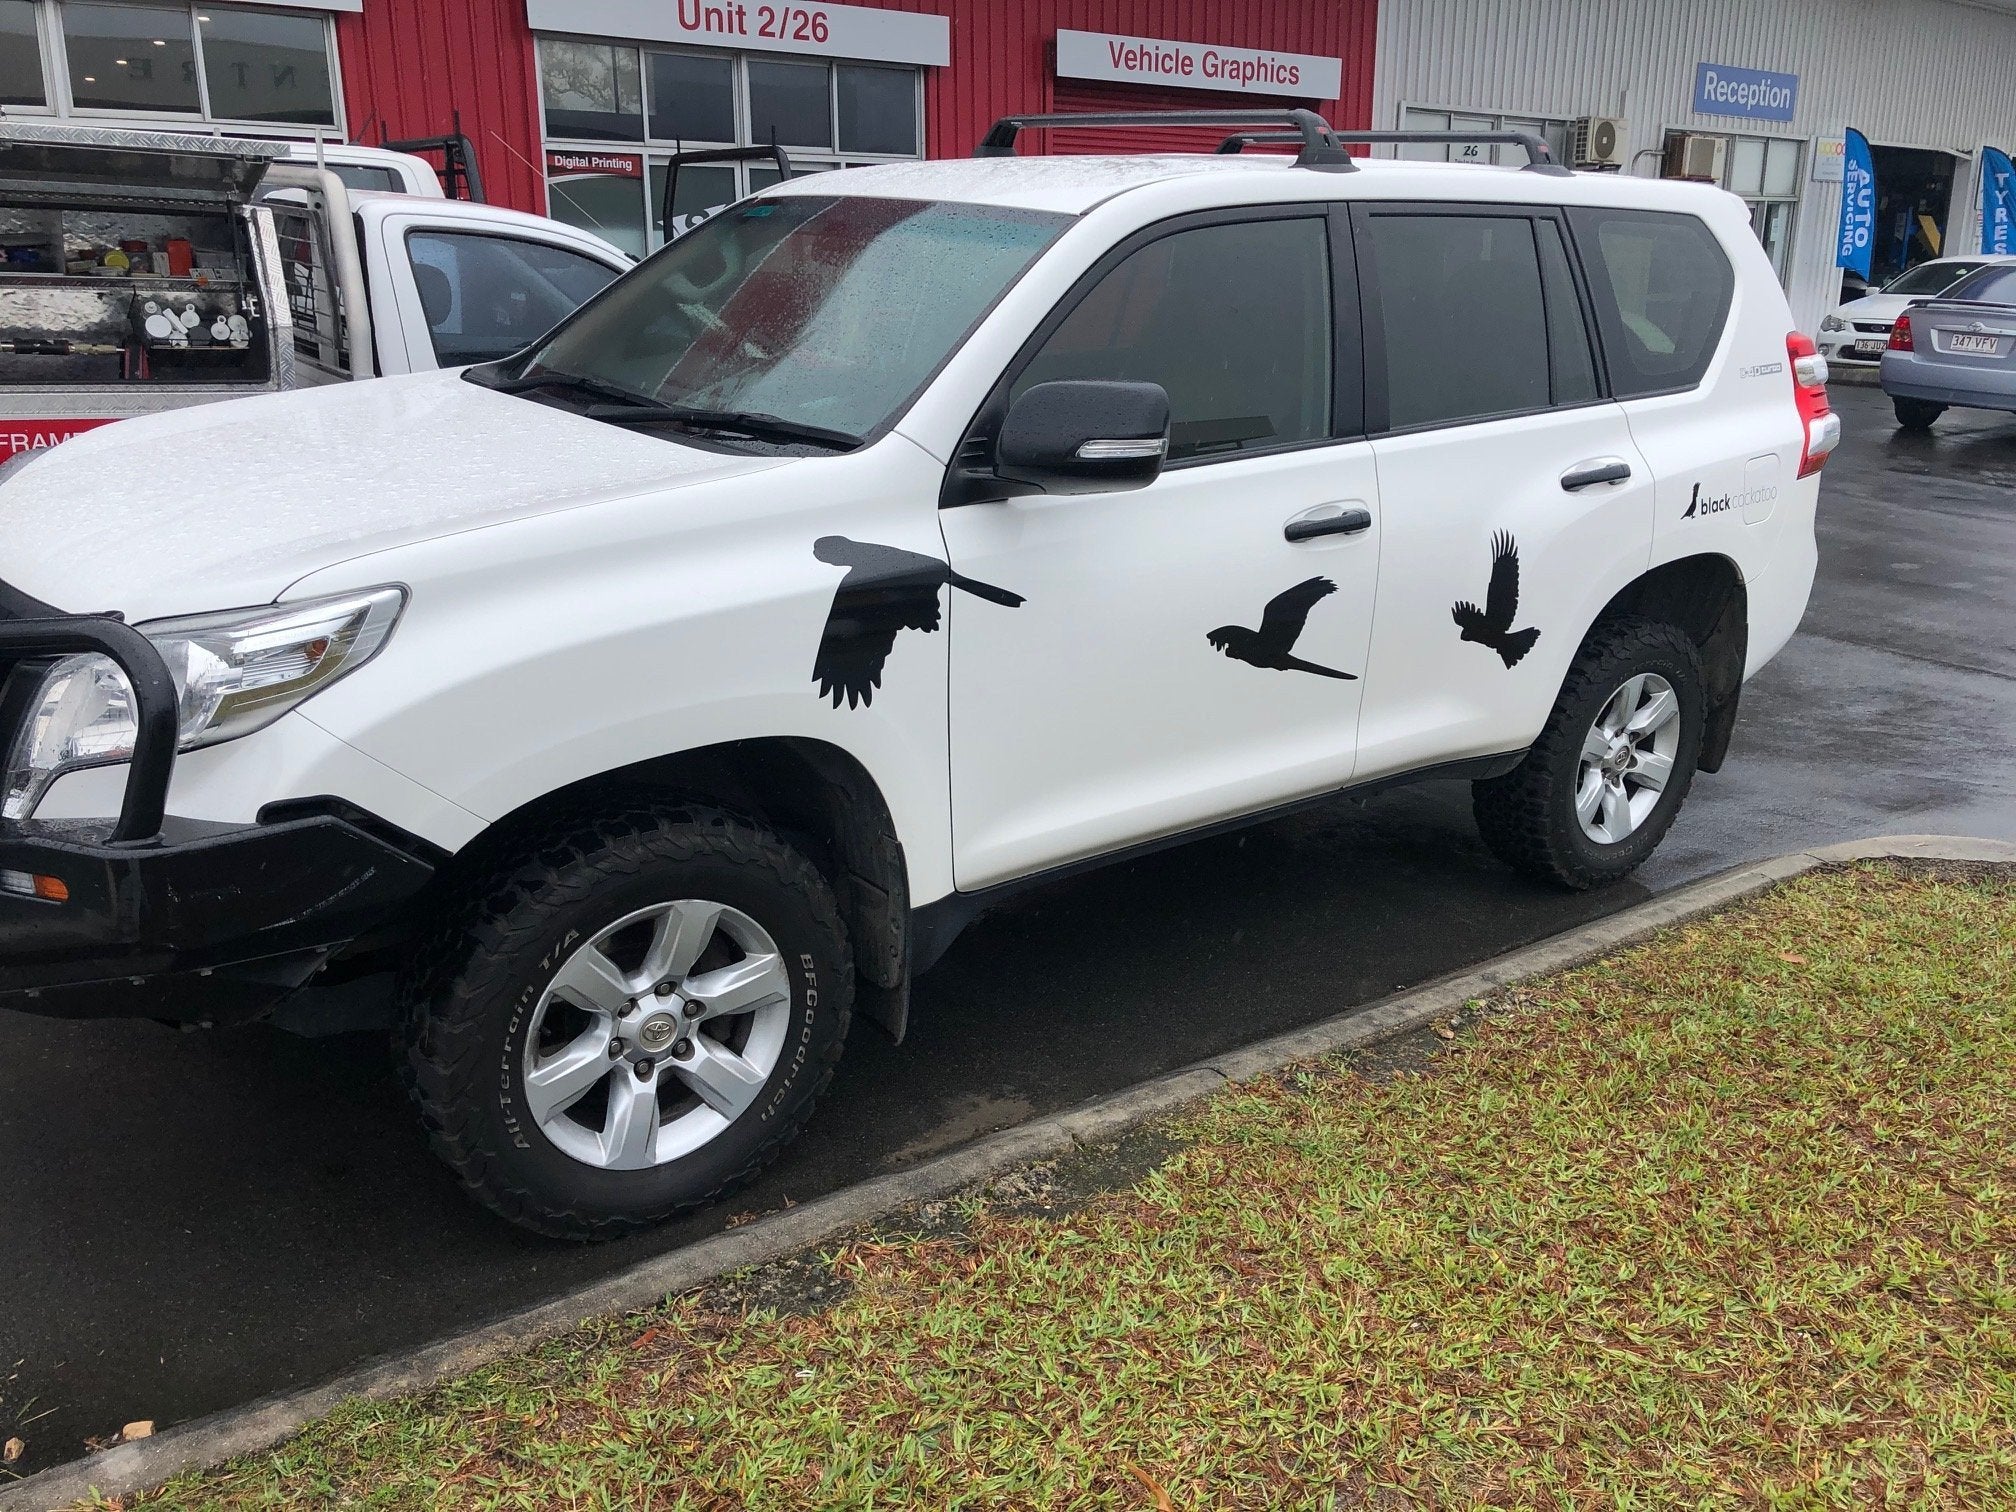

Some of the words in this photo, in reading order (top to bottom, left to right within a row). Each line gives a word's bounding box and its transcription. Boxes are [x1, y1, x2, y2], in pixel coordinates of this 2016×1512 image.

[678, 0, 747, 35] Unit
[757, 6, 829, 43] 2/26
[1108, 41, 1194, 75] Vehicle
[1202, 50, 1300, 87] Graphics
[1704, 70, 1791, 111] Reception
[554, 155, 588, 169] Digital
[592, 157, 632, 171] Printing
[1463, 145, 1478, 156] 26
[1841, 158, 1859, 257] SERVICING
[1855, 168, 1872, 247] AUTO
[1995, 173, 2009, 255] TYRES
[1953, 336, 1972, 347] 347
[1975, 337, 1998, 350] VFV
[0, 432, 84, 453] FRAM
[760, 954, 819, 1122] BFGoodrich
[500, 985, 534, 1149] All-Terrain
